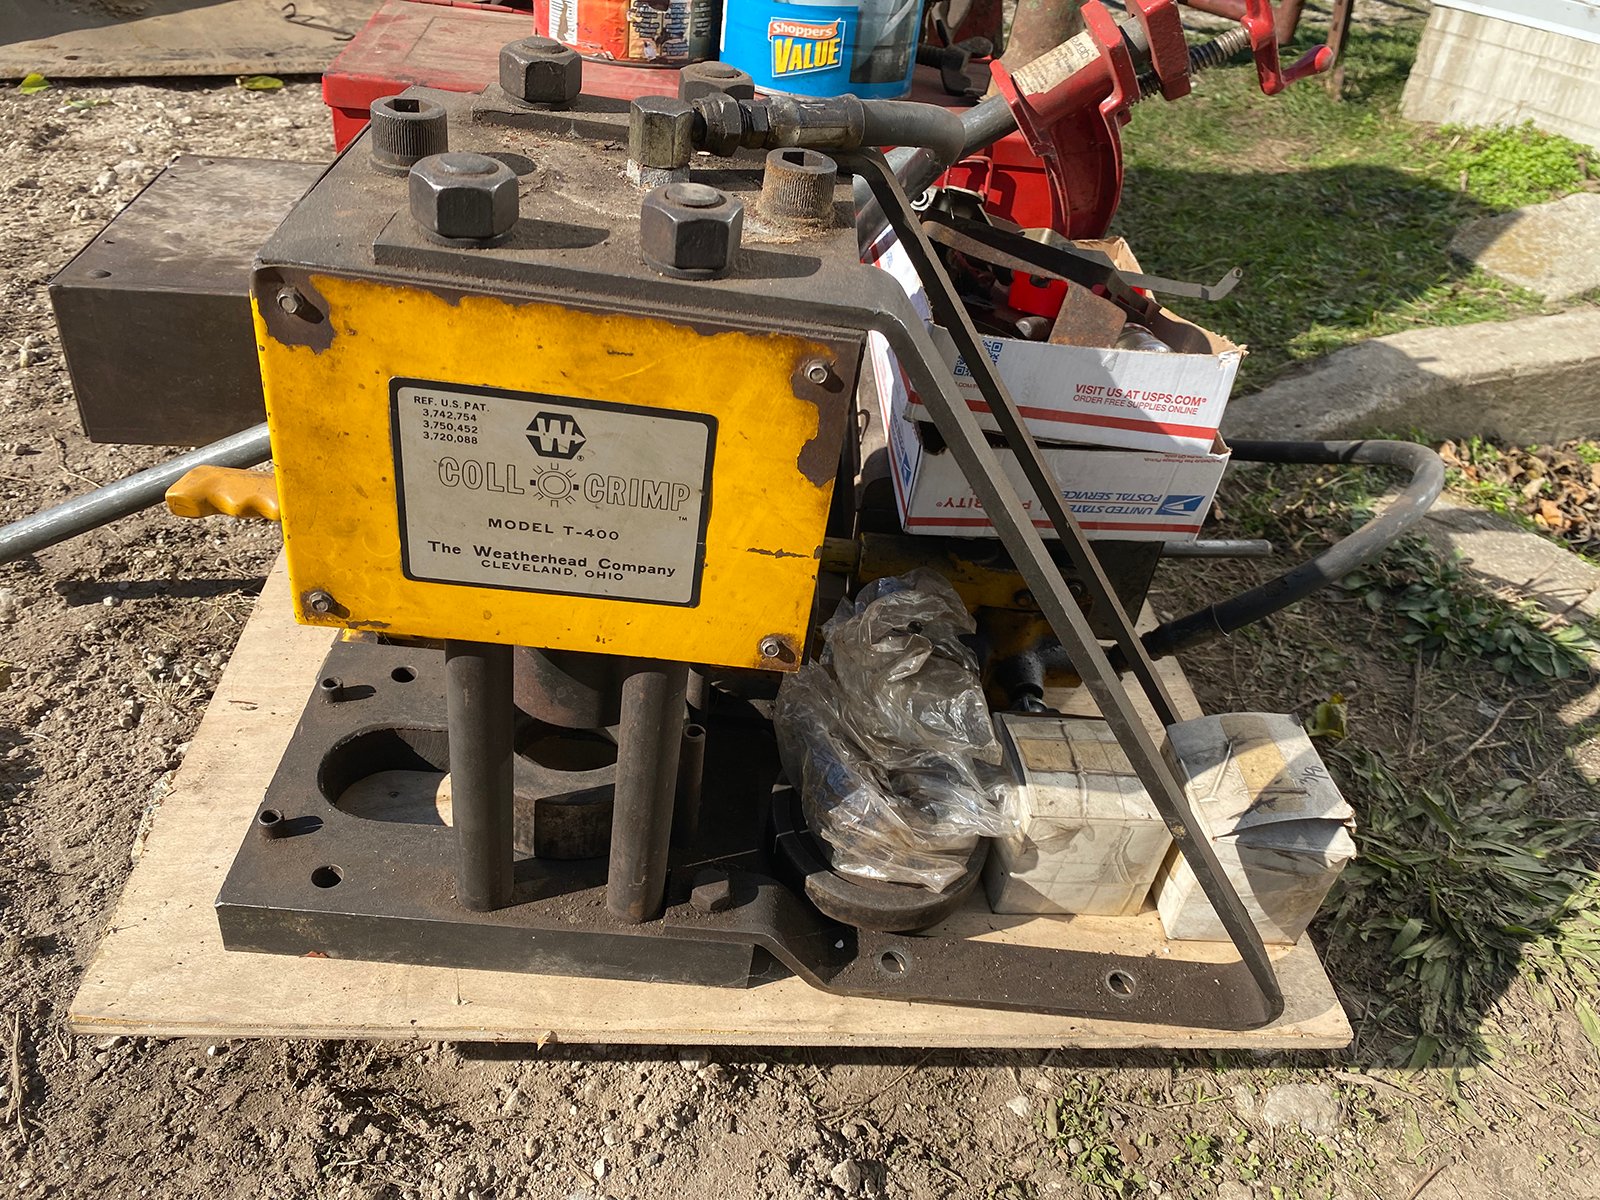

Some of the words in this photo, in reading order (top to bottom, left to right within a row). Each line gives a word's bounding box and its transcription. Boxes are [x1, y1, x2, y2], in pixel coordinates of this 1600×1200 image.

[772, 22, 833, 37] Shoppers
[775, 37, 841, 74] VALUE
[1075, 384, 1105, 395] VISIT
[1106, 388, 1123, 398] US
[1124, 390, 1141, 400] AT
[413, 395, 438, 406] REF.
[441, 398, 462, 409] U.S.
[464, 401, 490, 412] PAT.
[1073, 394, 1103, 404] ORDER
[1104, 398, 1126, 407] FREE
[1127, 400, 1167, 412] SUPPLIES
[1167, 405, 1199, 415] ONLINE
[422, 408, 477, 422] 3,742,754
[423, 420, 478, 434] 3,750,452
[423, 431, 478, 445] 3,720,088
[1061, 490, 1114, 500] SERVICE
[1115, 493, 1163, 502] POSTAL
[1069, 504, 1105, 514] STATE
[1105, 505, 1154, 515] UNITED
[488, 518, 554, 534] MODEL
[563, 525, 620, 541] T-400
[428, 540, 462, 555] The
[473, 545, 588, 567] Weatherhead
[598, 558, 676, 577] Company
[481, 560, 577, 578] CLEVELAND,
[585, 570, 624, 581] OHIO
